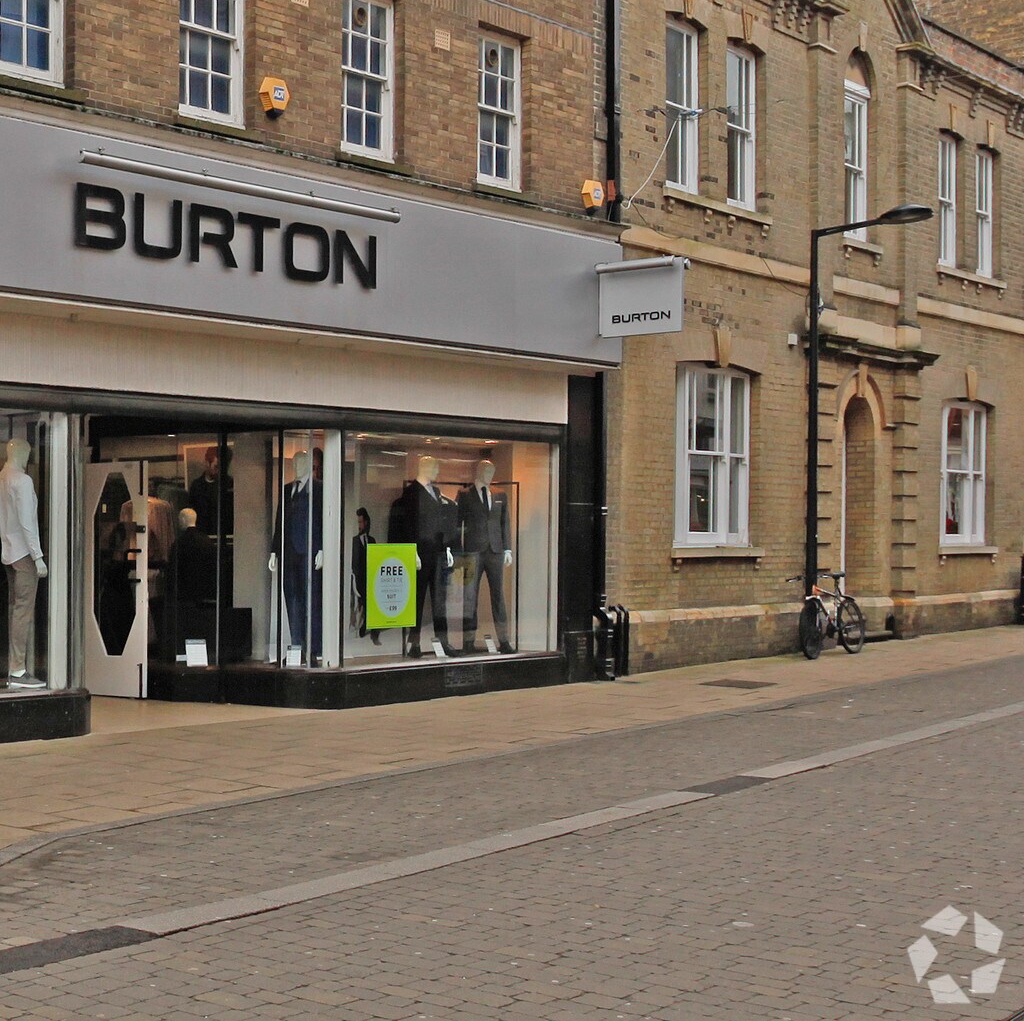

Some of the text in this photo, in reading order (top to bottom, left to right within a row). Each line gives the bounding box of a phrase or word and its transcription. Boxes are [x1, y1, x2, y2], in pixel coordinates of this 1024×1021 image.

[74, 181, 377, 289] BURTON
[611, 310, 671, 324] BURTON
[380, 566, 403, 576] FREE
